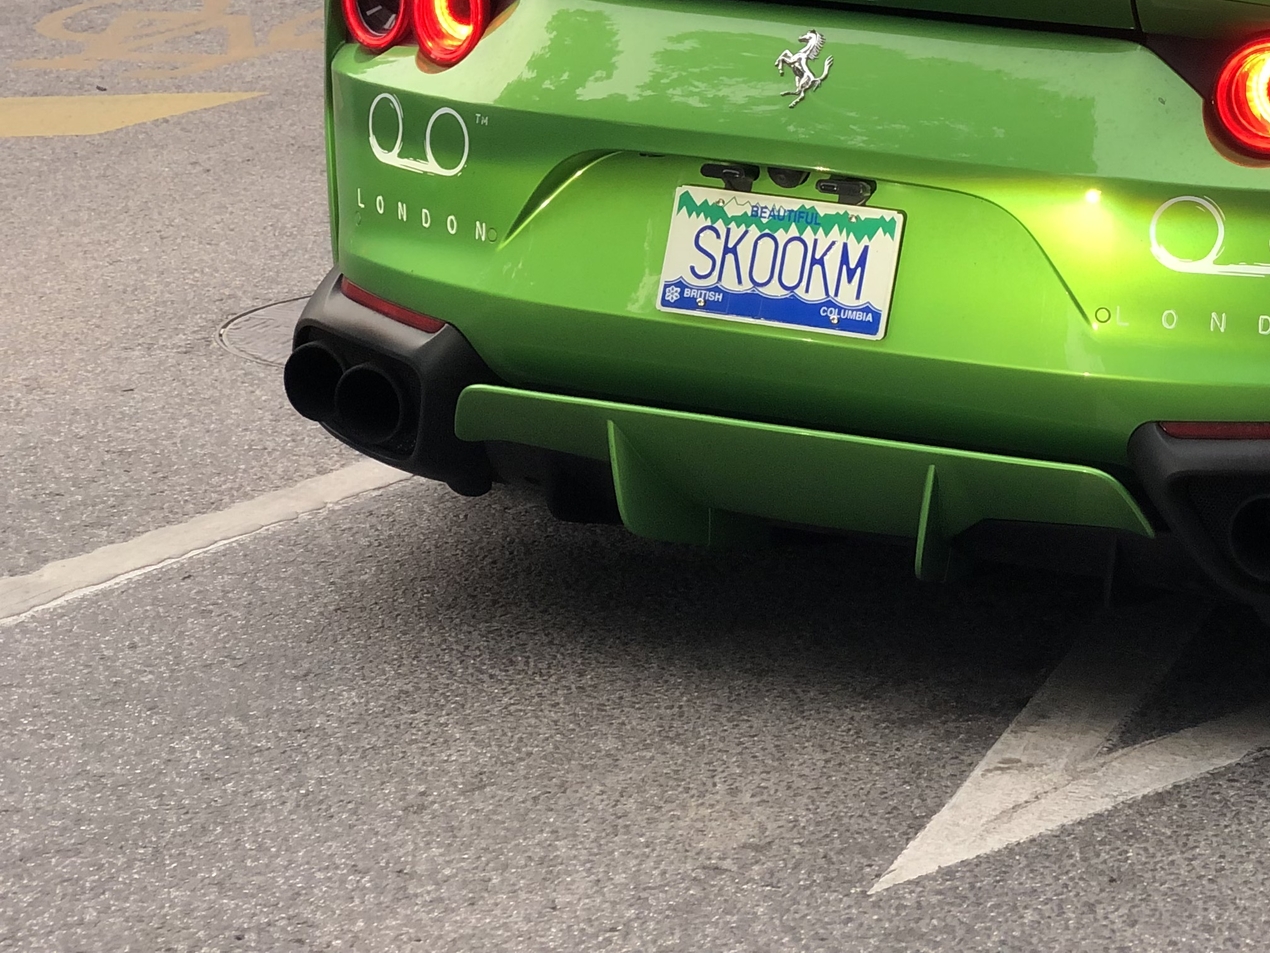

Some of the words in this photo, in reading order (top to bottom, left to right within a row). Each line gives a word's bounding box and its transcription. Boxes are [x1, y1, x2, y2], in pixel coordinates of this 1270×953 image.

[357, 187, 487, 242] LONDON
[750, 204, 822, 227] BEAUTIFUL
[689, 224, 870, 301] SKOOKM
[683, 288, 723, 302] BRITISH
[819, 305, 874, 323] COLUMBIA
